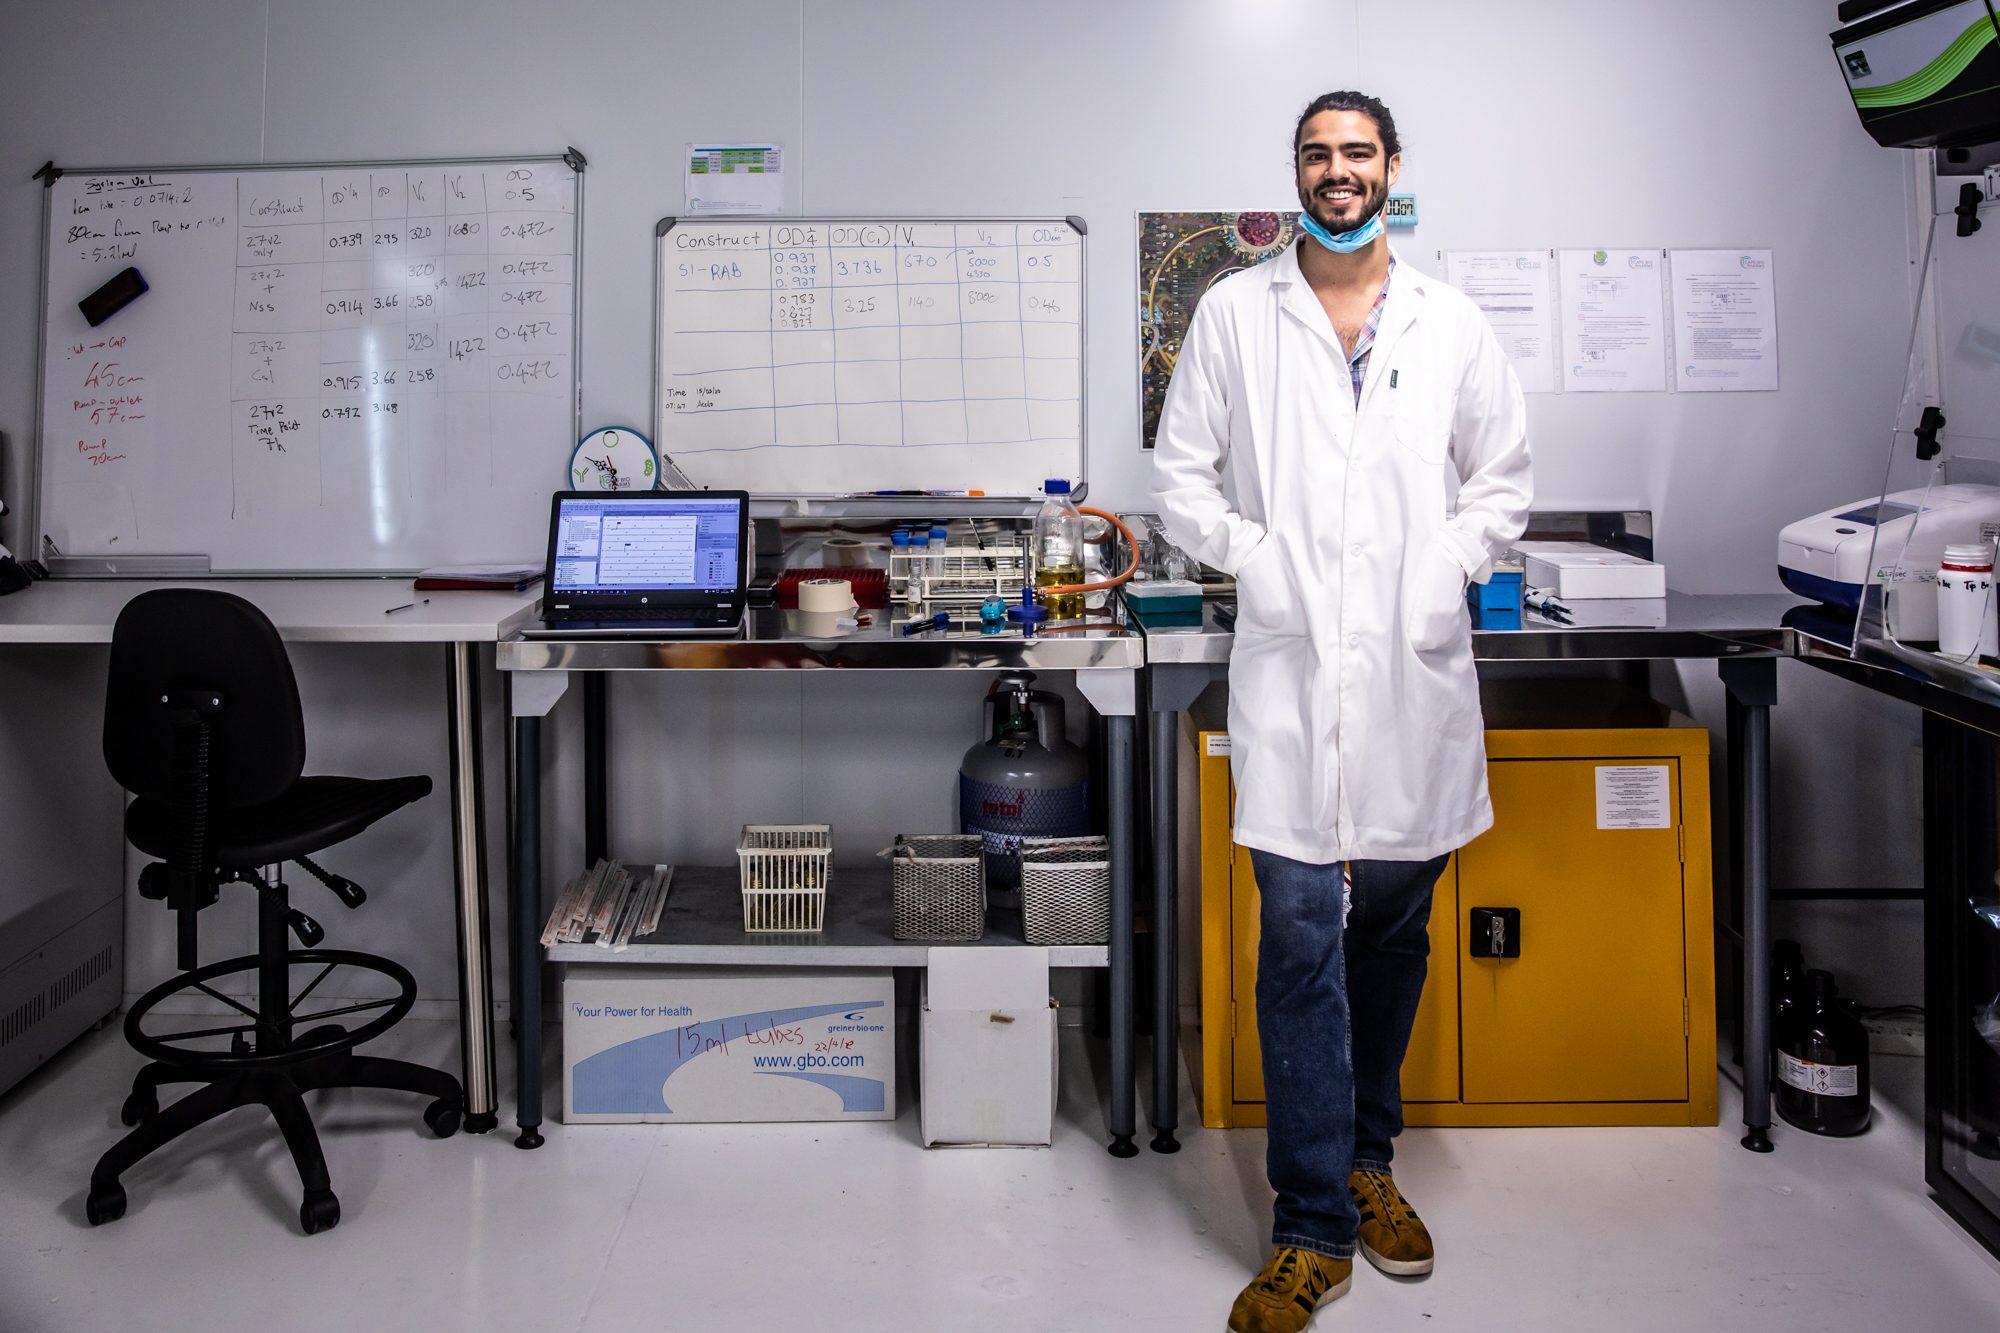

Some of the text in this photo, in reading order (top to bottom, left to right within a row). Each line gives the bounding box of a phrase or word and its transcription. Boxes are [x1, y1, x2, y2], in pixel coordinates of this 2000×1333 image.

[328, 232, 363, 248] 0.739
[408, 226, 432, 240] 320
[675, 230, 761, 249] Construct
[407, 368, 436, 383] 258
[667, 387, 688, 398] Time
[321, 406, 362, 420] 0.792
[576, 1005, 693, 1018] Your Power for Health
[828, 1024, 855, 1033] greiner
[752, 1052, 866, 1071] www.gbo.com
